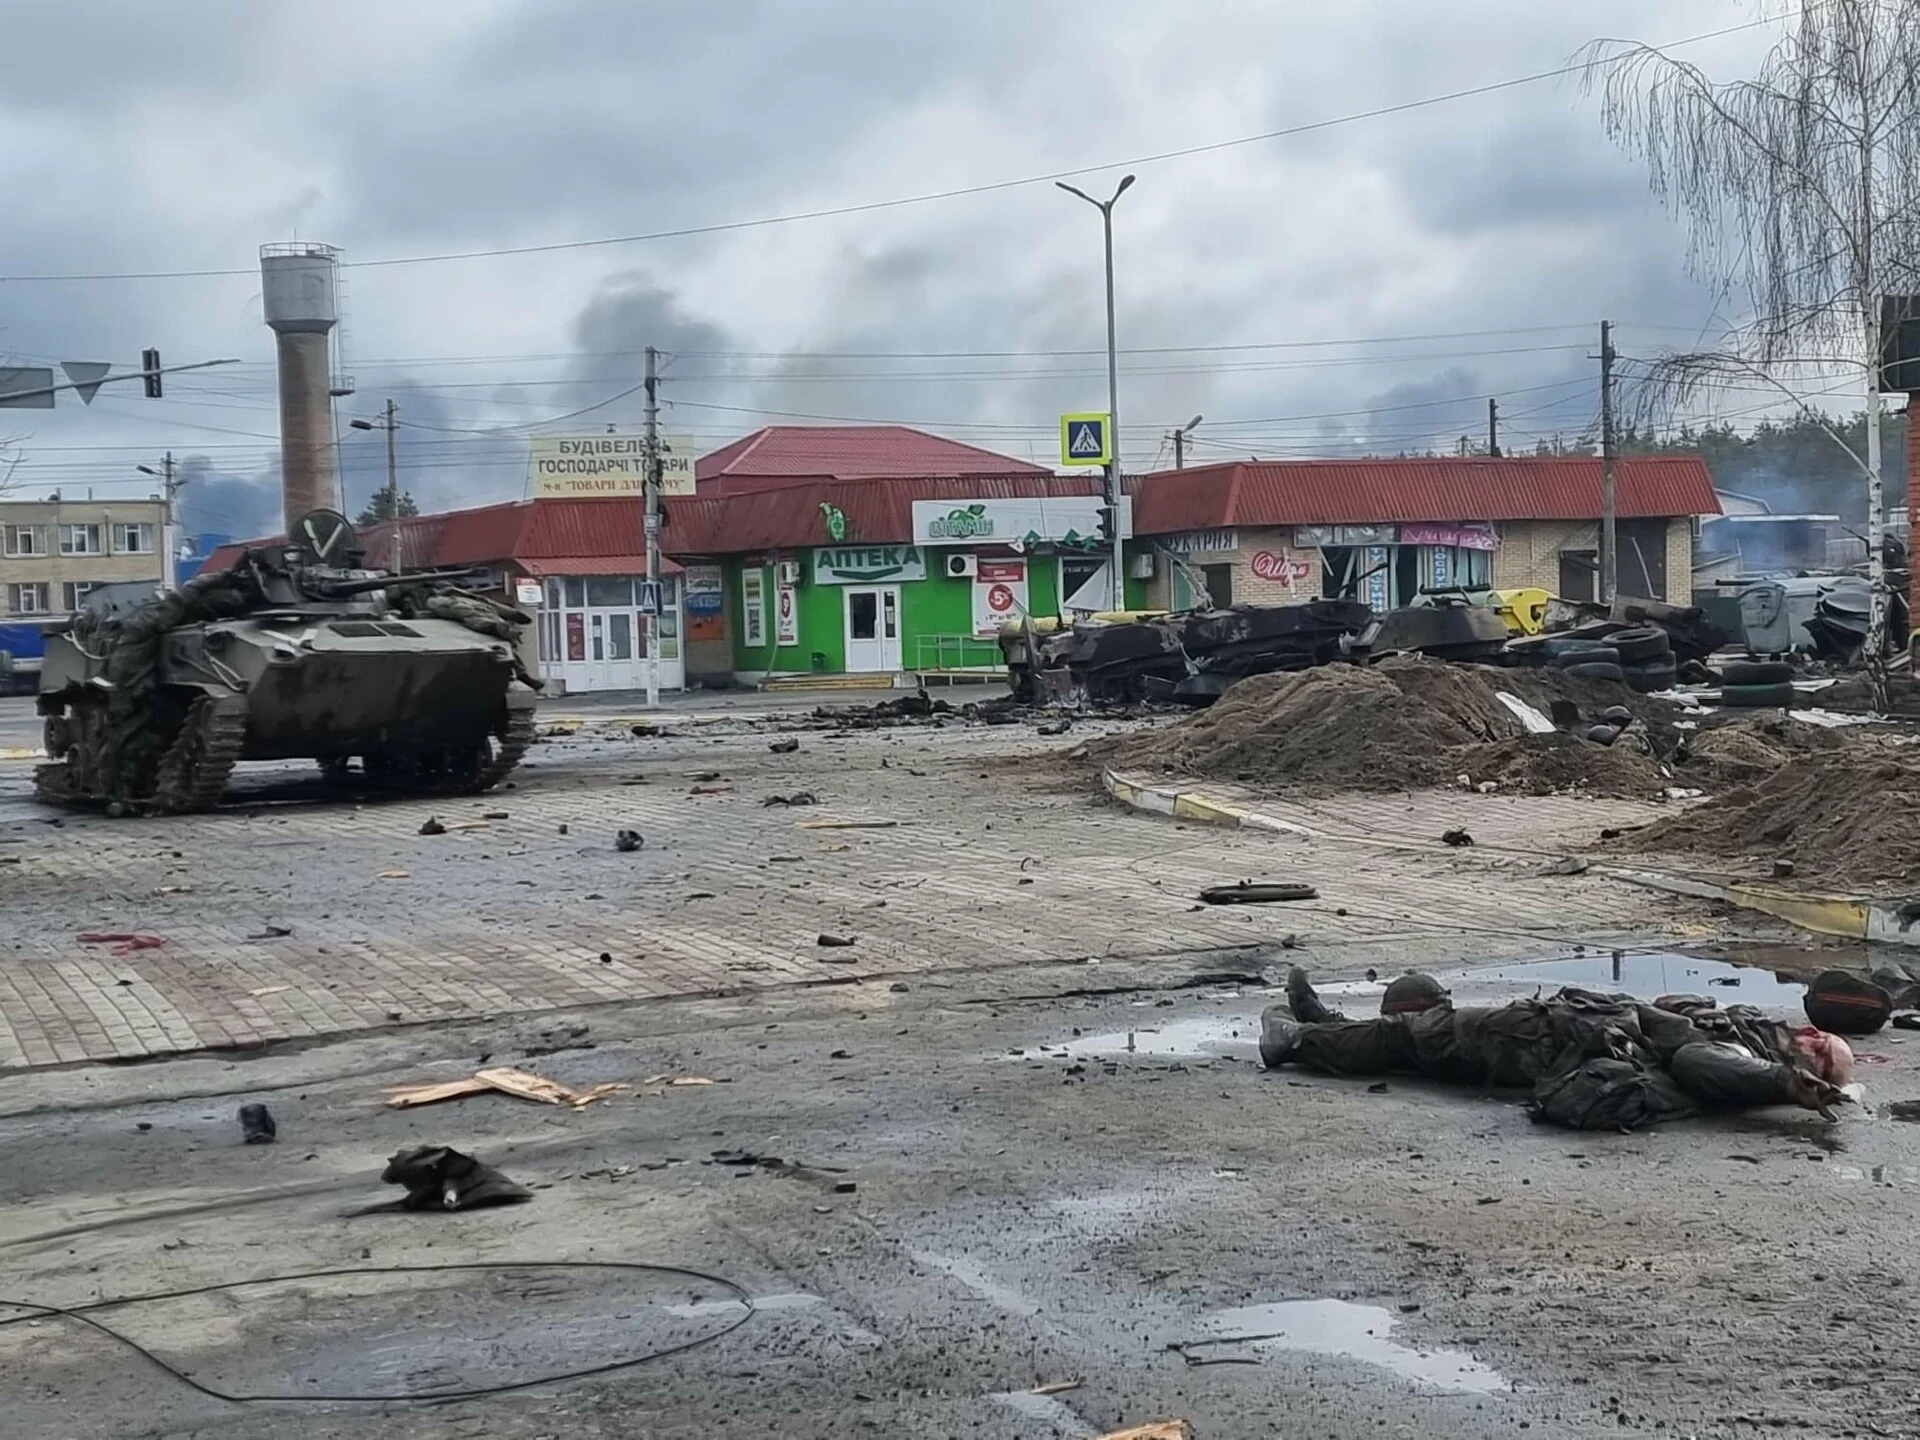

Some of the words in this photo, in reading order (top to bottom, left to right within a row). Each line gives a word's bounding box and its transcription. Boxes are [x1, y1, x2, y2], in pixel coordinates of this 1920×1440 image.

[539, 458, 629, 475] ГОСПОДАРЧІ
[303, 518, 343, 558] V
[817, 546, 922, 569] АПТЕКА
